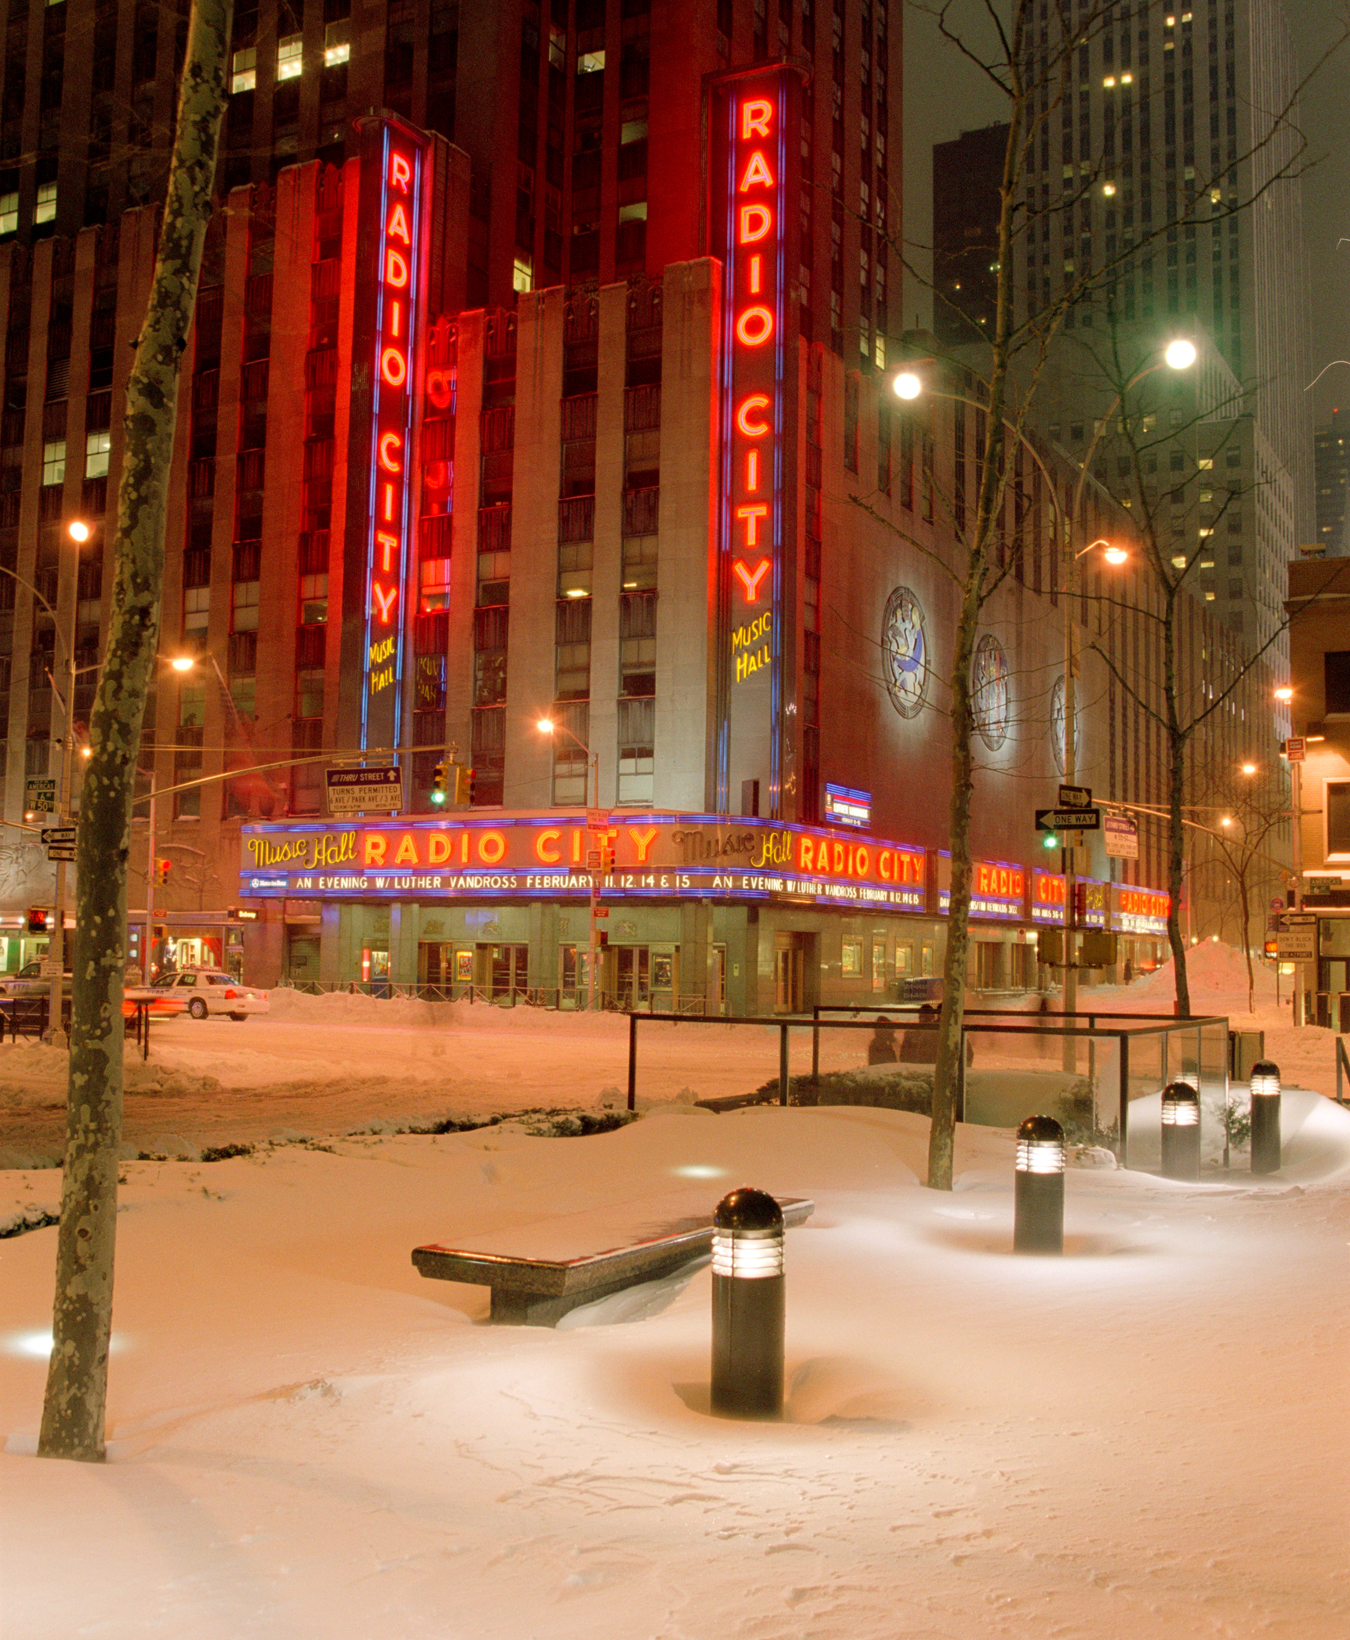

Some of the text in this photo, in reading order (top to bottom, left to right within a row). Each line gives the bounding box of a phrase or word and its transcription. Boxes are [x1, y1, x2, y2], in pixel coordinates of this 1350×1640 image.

[733, 99, 774, 602] RADIO CITY
[373, 152, 411, 623] RADIO CITY
[732, 611, 771, 655] MUSIC
[369, 636, 395, 669] MUSIC
[736, 644, 771, 683] HALL
[332, 785, 398, 796] TURNS PERMITTED
[340, 772, 385, 782] THRU STREET
[37, 802, 49, 812] 50
[335, 795, 346, 804] AVE
[352, 795, 366, 803] PARK
[368, 794, 379, 803] AVE
[391, 794, 401, 802] AVE
[1062, 791, 1072, 799] ONE
[1055, 814, 1094, 824] ONE WAY
[248, 831, 358, 870] Music Hall
[365, 831, 505, 866] RADIO
[671, 829, 792, 868] Music Hall
[800, 837, 923, 883] RADIO CITY
[297, 877, 312, 889] AN
[319, 877, 367, 888] EVENING
[375, 877, 390, 888] W/
[394, 877, 441, 888] LUTHER
[450, 876, 518, 888] VANDROSS
[526, 875, 593, 888] FEBRUARY
[641, 875, 655, 888] 14
[660, 875, 670, 888] &
[675, 875, 690, 888] 15
[712, 875, 733, 888] AN
[742, 876, 784, 892] EVENING
[786, 880, 796, 892] W/
[797, 880, 822, 895] LUTHER
[825, 883, 857, 898] VANDROSS
[859, 887, 888, 902] FEBRUARY
[980, 866, 1022, 895] RADIO
